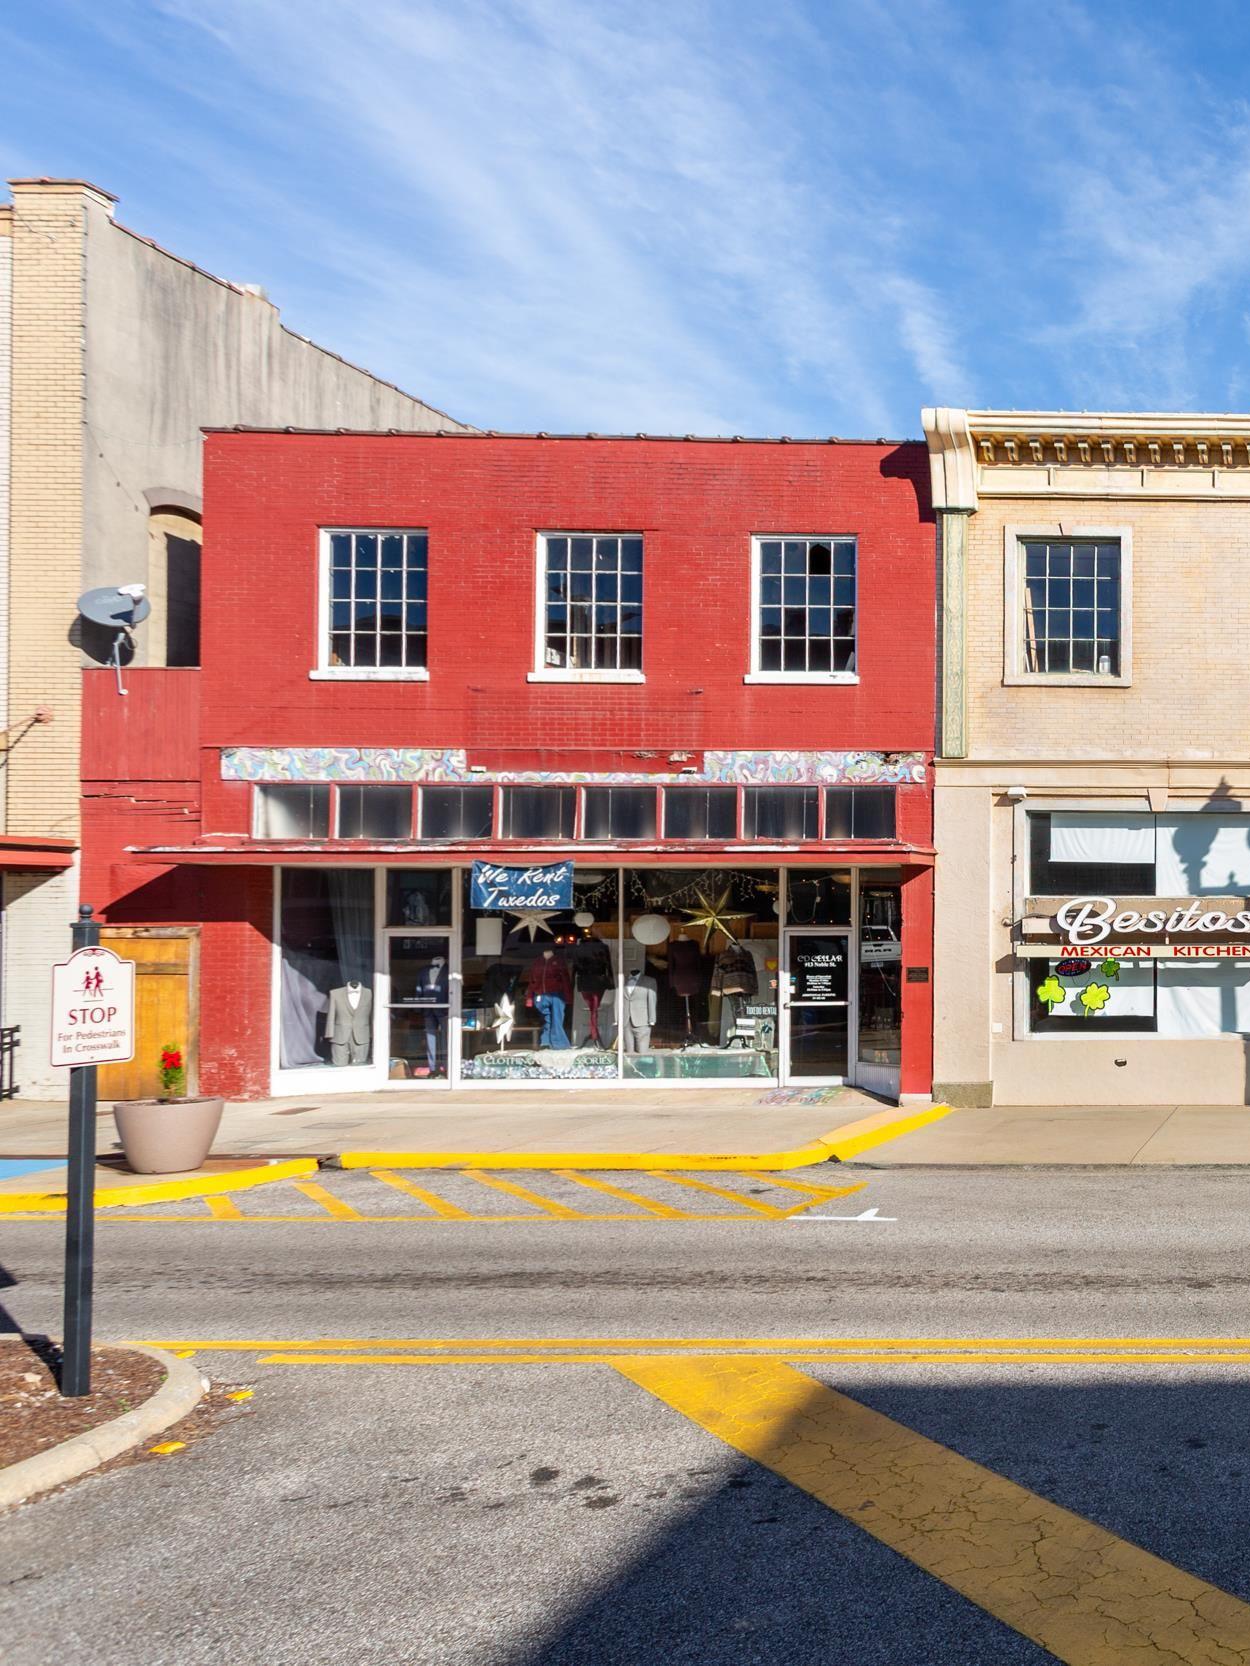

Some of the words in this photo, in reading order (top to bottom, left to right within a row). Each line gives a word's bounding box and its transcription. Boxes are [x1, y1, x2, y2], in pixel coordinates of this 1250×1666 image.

[478, 864, 509, 884] We
[517, 866, 569, 885] Rent
[483, 886, 560, 907] Tuxedos
[810, 954, 843, 962] CELLAR
[1060, 946, 1151, 957] MEXICAN
[68, 1006, 117, 1026] STOP
[58, 1033, 73, 1041] For
[76, 1029, 126, 1040] Pedestrians
[63, 1044, 73, 1054] In
[75, 1040, 120, 1053] Crosswalk
